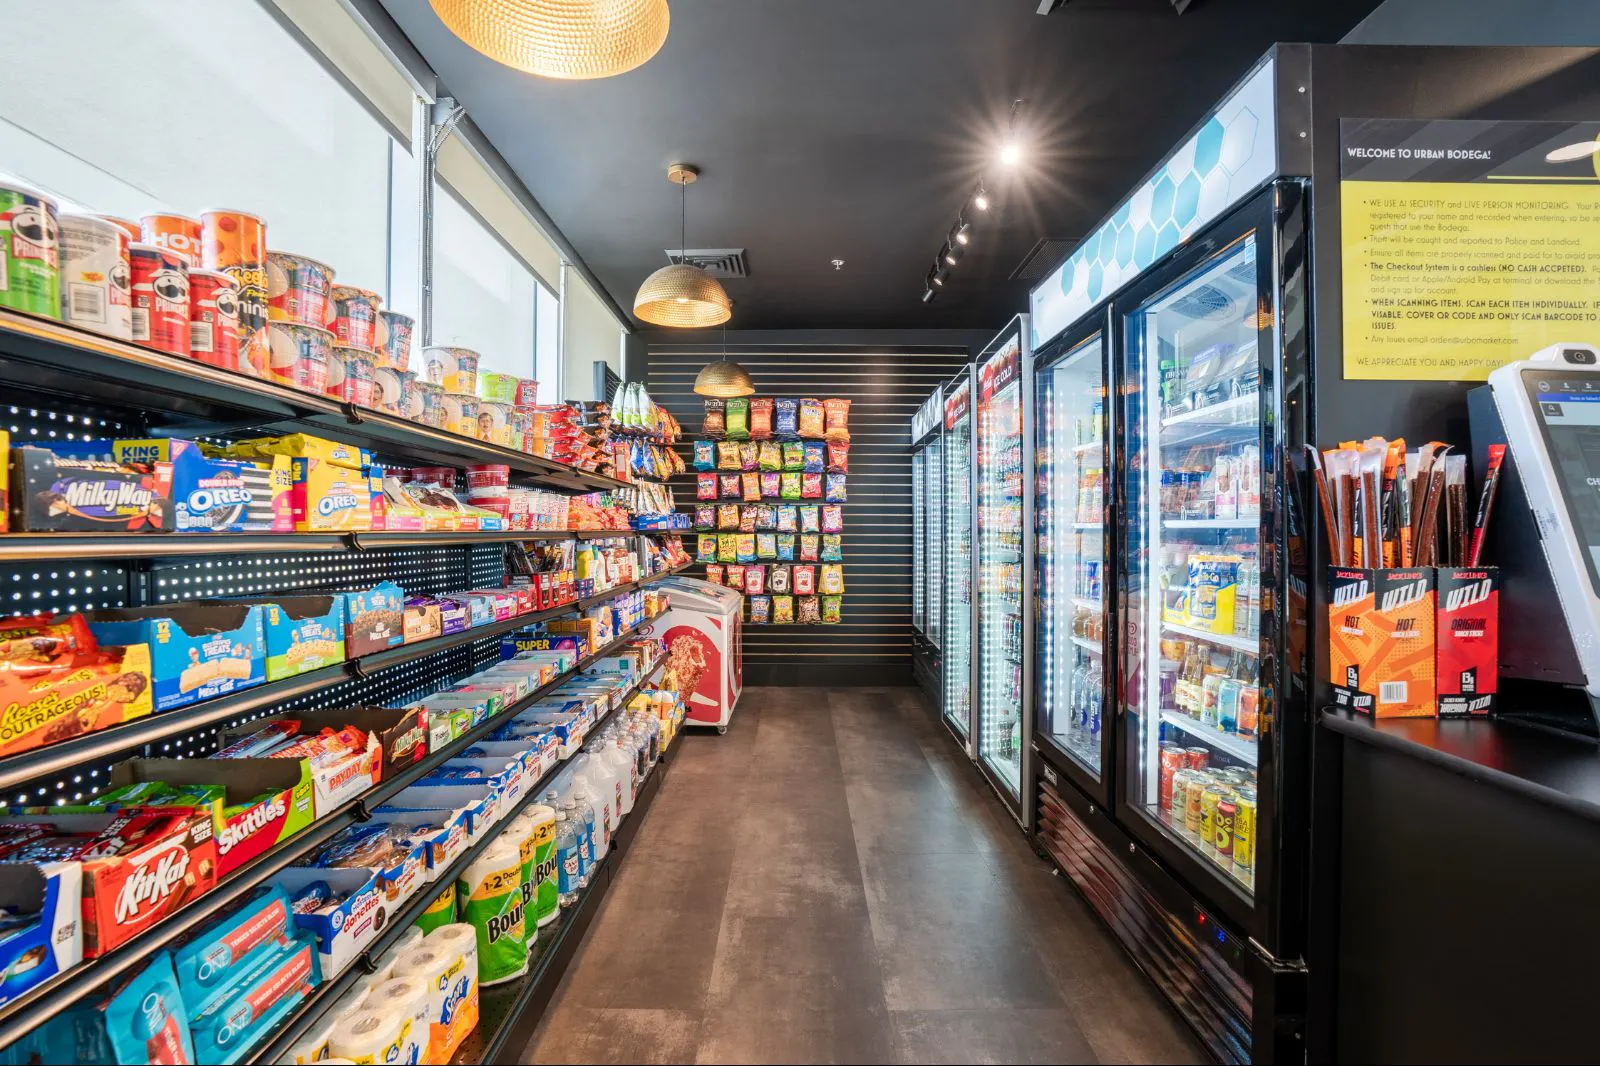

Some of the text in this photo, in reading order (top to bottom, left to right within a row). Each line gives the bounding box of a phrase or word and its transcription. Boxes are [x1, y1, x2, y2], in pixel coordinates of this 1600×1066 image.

[1347, 148, 1491, 160] WELCOME TO URBAN BODEGA!
[1410, 200, 1445, 208] SECURITY
[1426, 264, 1449, 272] System
[1437, 312, 1449, 320] QR
[1371, 358, 1417, 366] APPRECIATE
[1458, 359, 1483, 367] HAPPY
[1000, 366, 1012, 382] COLD
[122, 446, 160, 457] KING
[276, 476, 292, 486] SIZE
[64, 482, 152, 512] Milky Way
[188, 488, 252, 514] OREO
[318, 496, 358, 516] OREO
[1334, 580, 1368, 608] WILD
[1381, 578, 1427, 613] WILD
[1446, 578, 1492, 613] WILD
[1345, 615, 1360, 628] HOT
[1395, 617, 1416, 631] HOT
[1451, 618, 1487, 630] ORIGINAL
[515, 639, 550, 651] SUPER
[0, 685, 105, 740] OUTRAGEOUS!
[328, 758, 361, 792] PAYDAY
[191, 818, 212, 837] KING
[218, 797, 286, 856] Skittles
[194, 829, 212, 844] SIZE
[484, 876, 502, 892] 1-2
[343, 895, 380, 933] donettes
[198, 954, 230, 981] ONE
[217, 1016, 250, 1044] ONE
